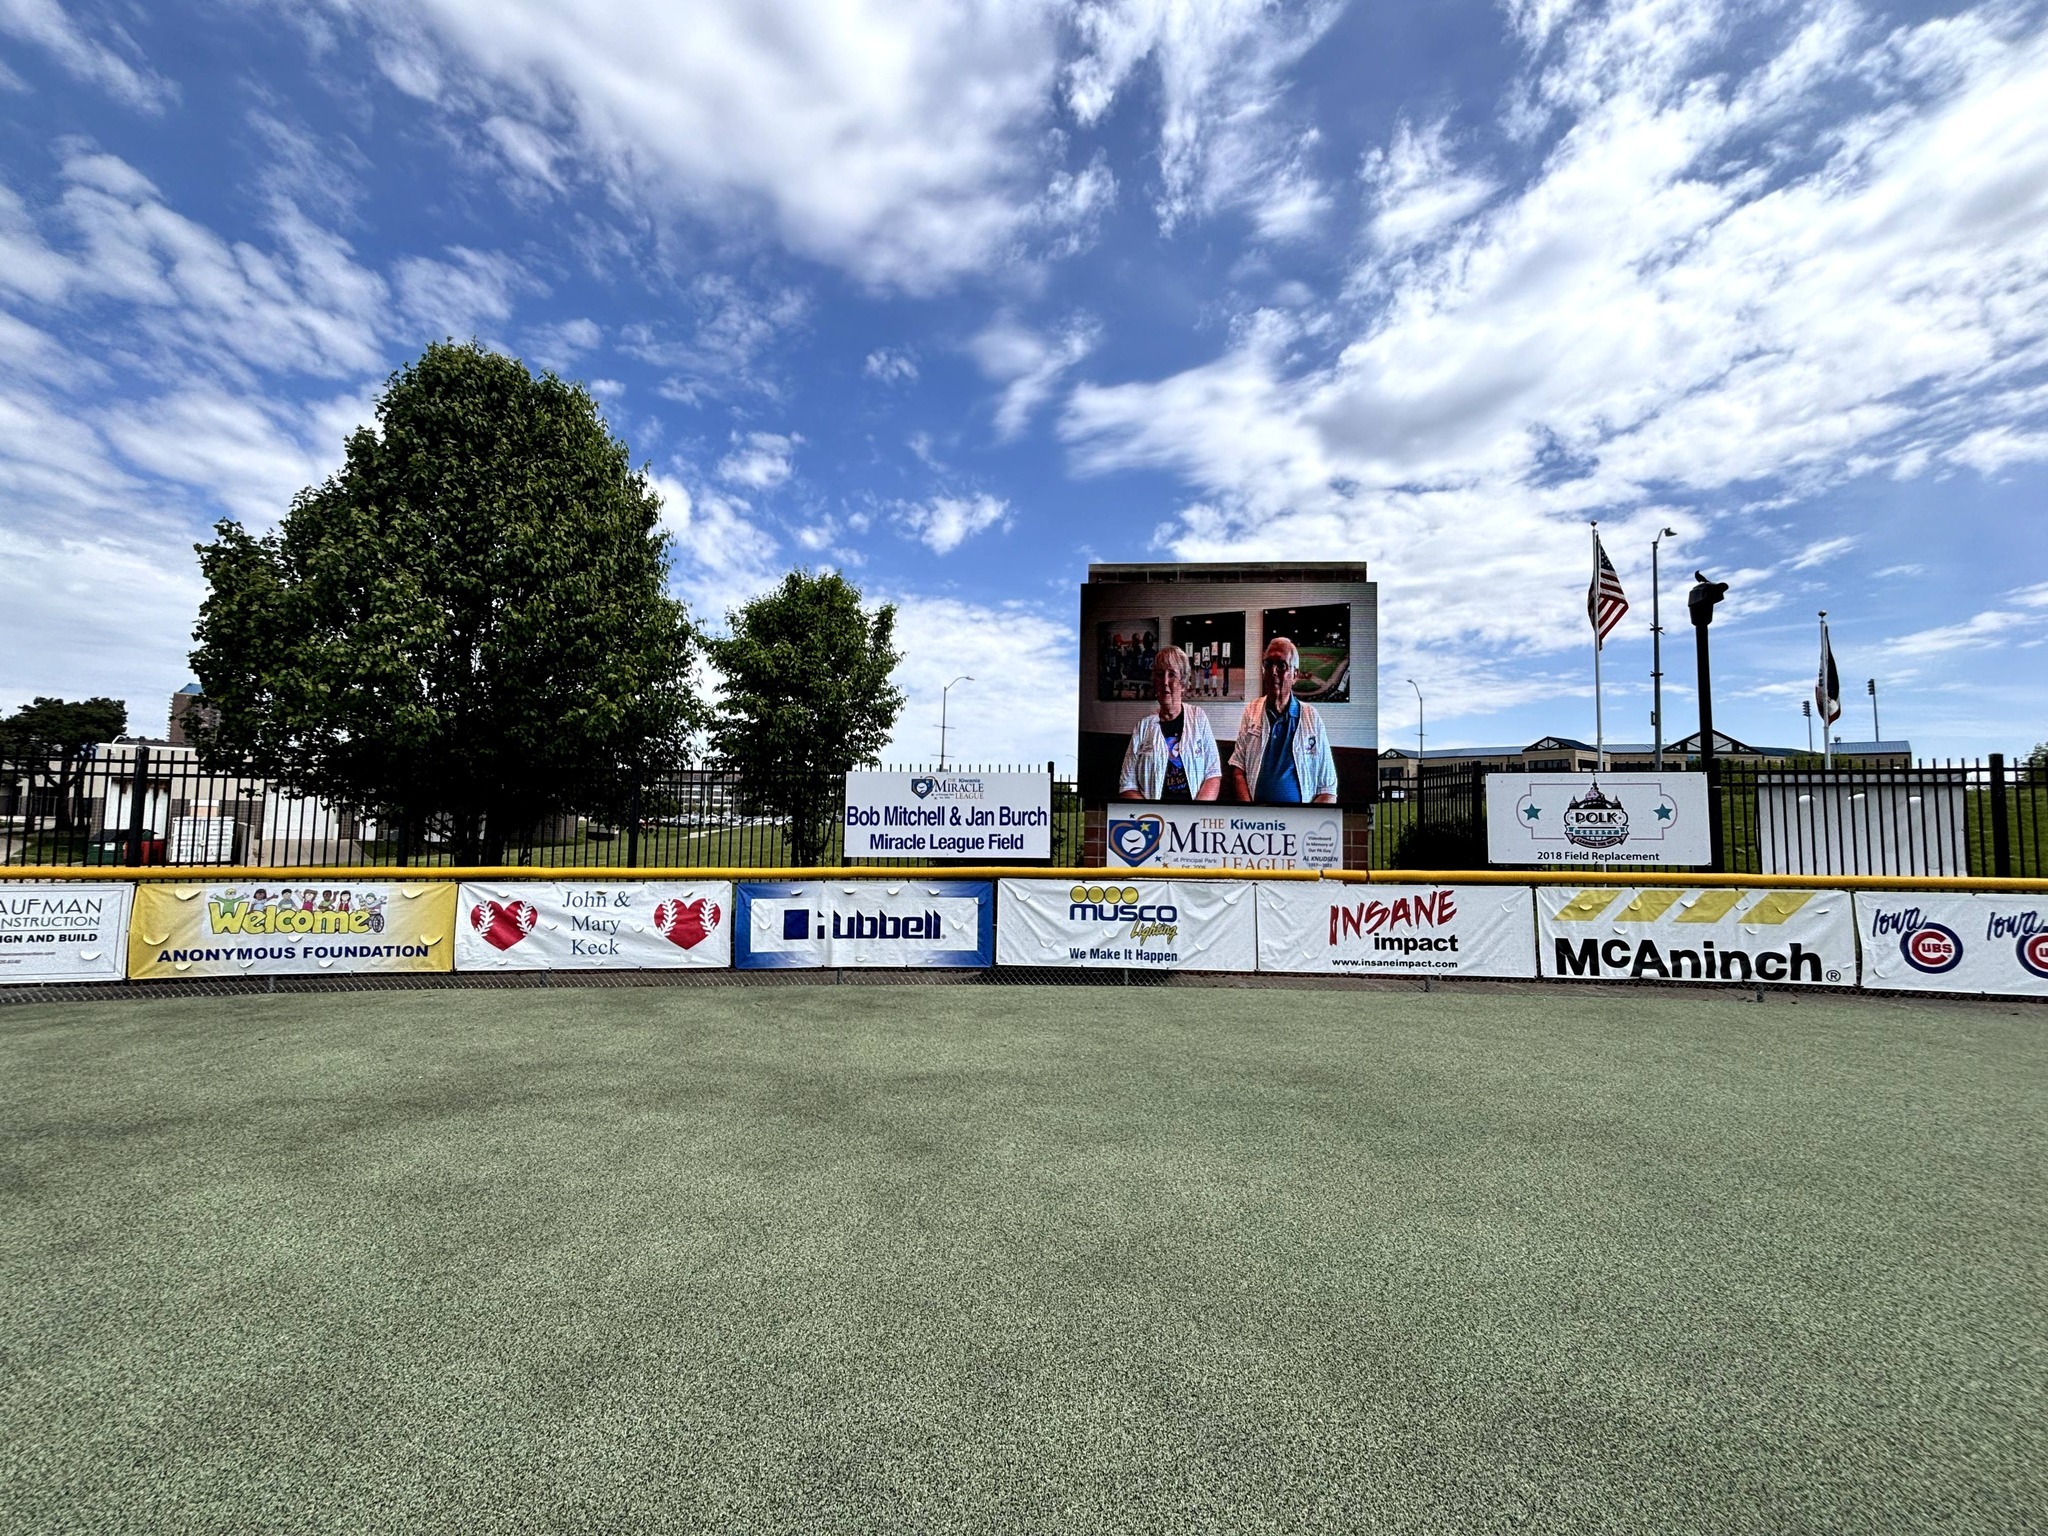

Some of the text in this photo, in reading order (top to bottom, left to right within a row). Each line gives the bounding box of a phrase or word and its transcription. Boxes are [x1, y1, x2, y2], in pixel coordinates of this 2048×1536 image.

[934, 779, 985, 793] MIRACLE
[847, 806, 1047, 826] Bob Mitchell & Jan Burch
[1200, 819, 1286, 831] THE Kiwanis
[1575, 812, 1618, 824] POLK
[870, 834, 1024, 853] Miracle League Field
[1167, 822, 1298, 857] MIRACLE
[1537, 851, 1660, 862] 2018 Field Replacement
[562, 891, 631, 908] John &
[208, 902, 372, 934] Welcome
[571, 915, 621, 935] Mary
[1329, 890, 1458, 946] INSANE
[1872, 908, 1927, 937] Iowa
[1987, 911, 2044, 941] Iowa
[26, 934, 55, 943] AND
[58, 933, 98, 942] BUILD
[1130, 920, 1178, 946] Lighting
[571, 938, 620, 955] Keck
[1374, 933, 1459, 956] impact
[157, 945, 429, 963] ANONYMOUS FOUNDATION
[1069, 948, 1178, 964] We Make It Happen
[1332, 959, 1458, 969] www.insaneimpact.com
